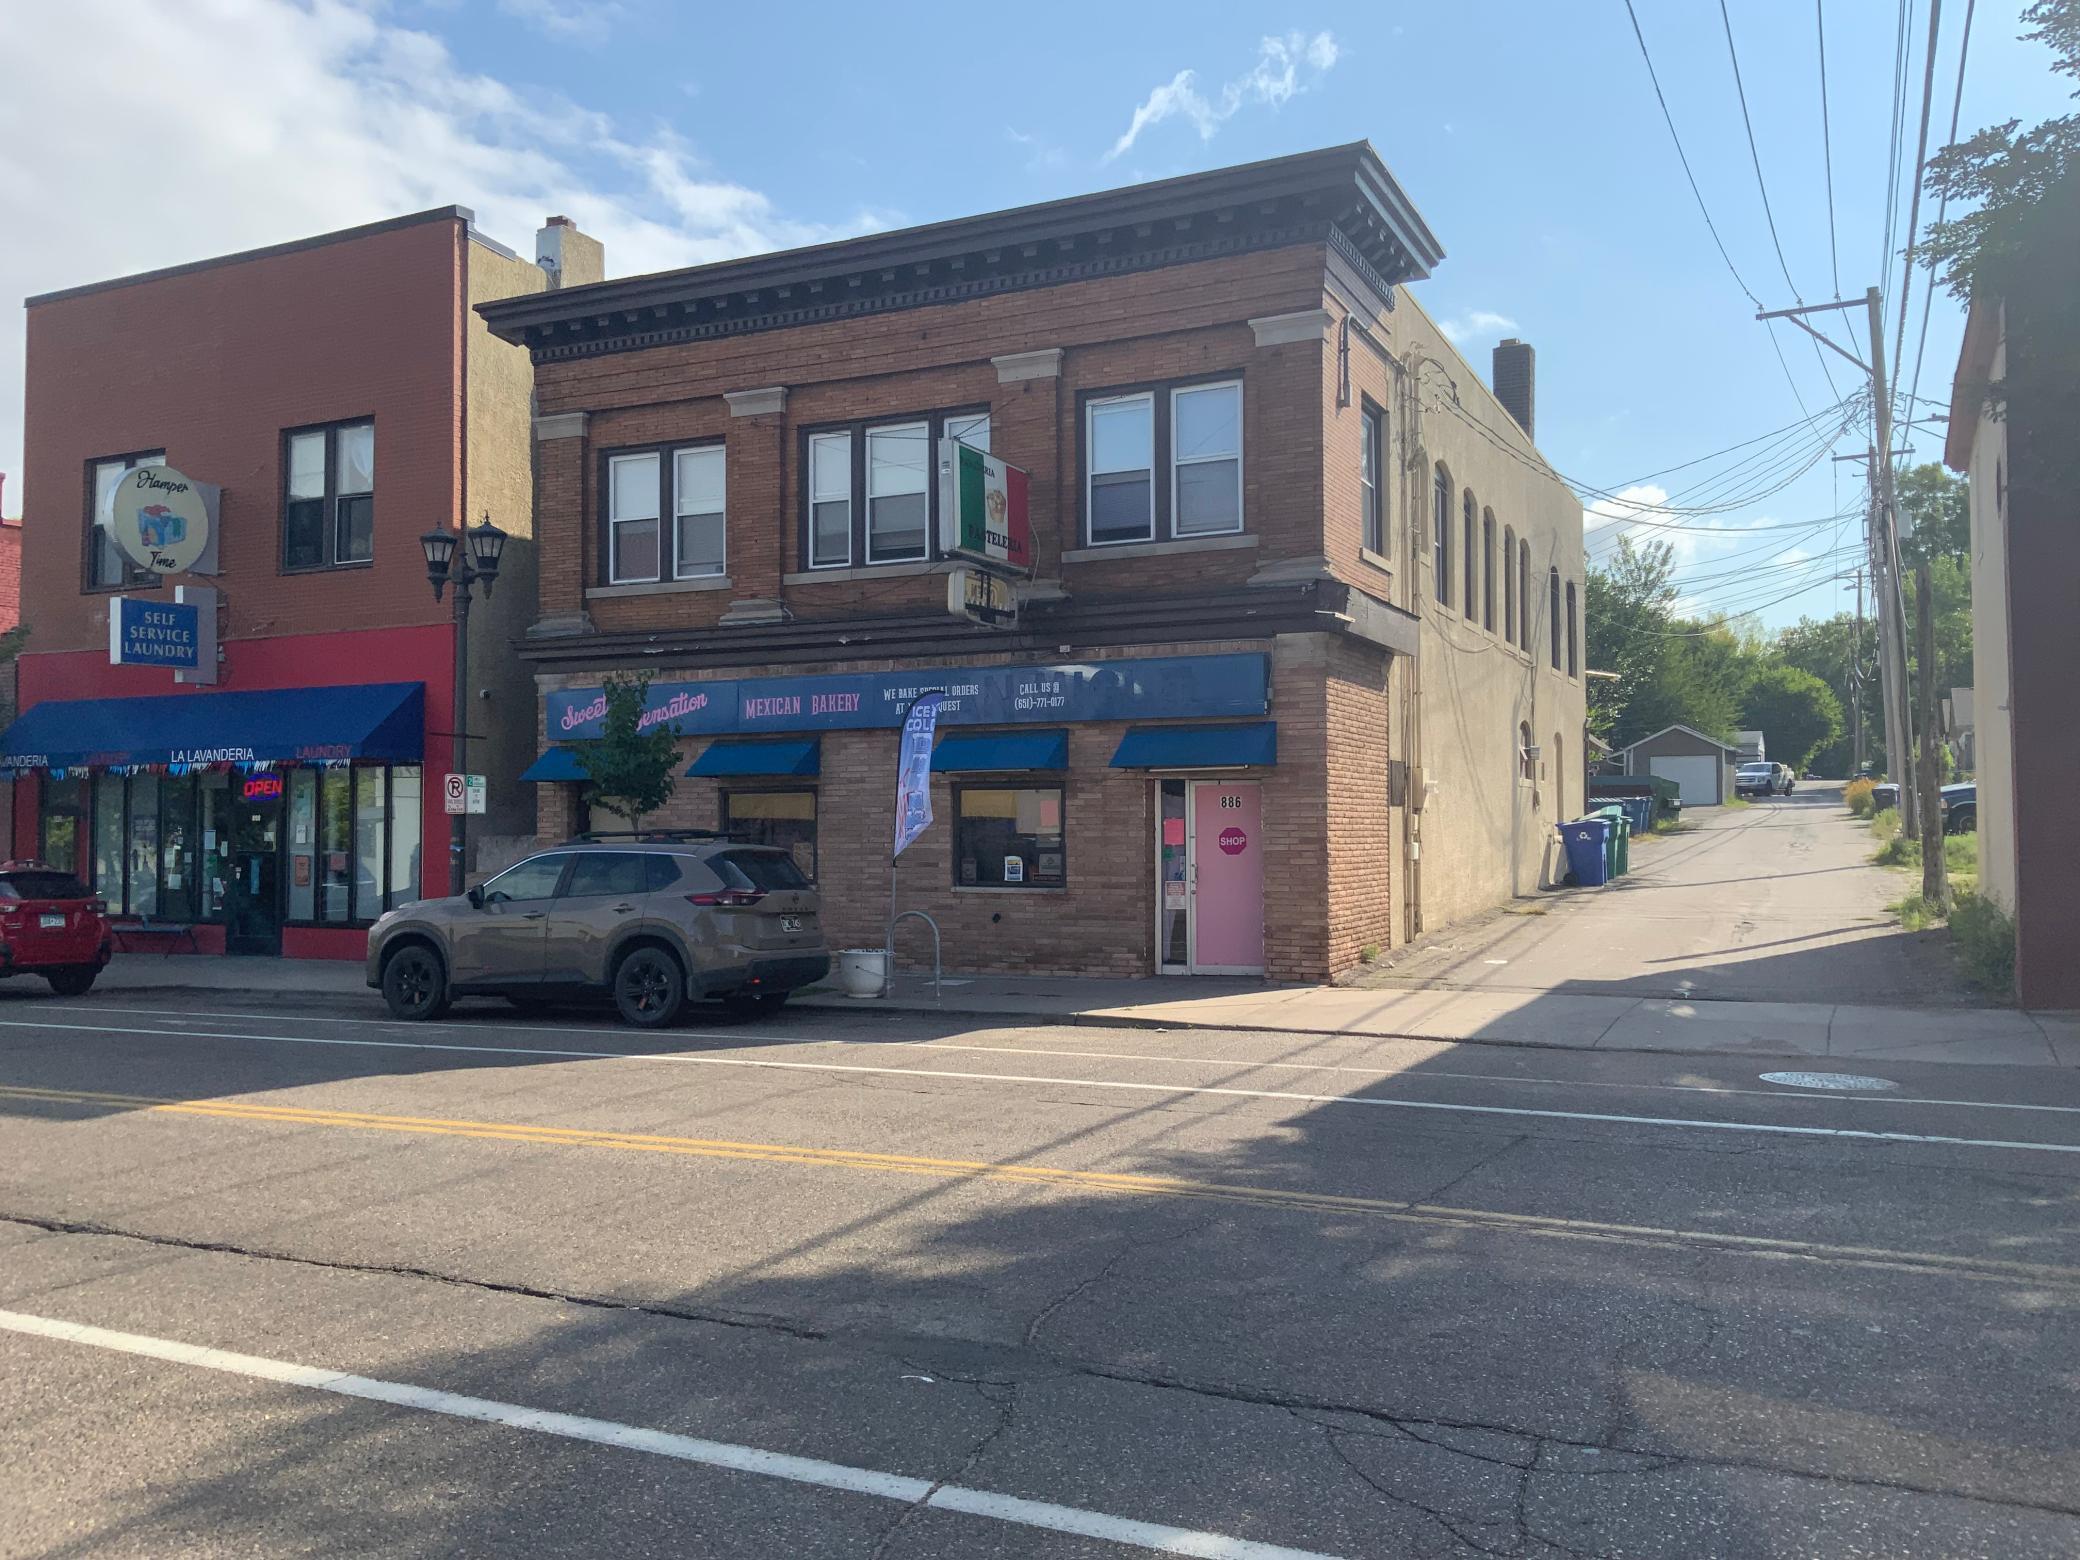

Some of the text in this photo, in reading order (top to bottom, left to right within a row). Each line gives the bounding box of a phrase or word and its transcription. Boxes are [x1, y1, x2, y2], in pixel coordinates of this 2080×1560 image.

[137, 470, 189, 495] Hamper
[151, 551, 177, 569] Time
[144, 611, 176, 626] SELF
[130, 625, 190, 643] SERVICE
[124, 642, 195, 658] LAUNDRY
[884, 687, 896, 700] WE
[898, 687, 917, 698] BAKE
[952, 684, 979, 696] ORDERS
[1020, 684, 1038, 695] CALL
[1041, 682, 1050, 692] US
[561, 694, 609, 730] Sweet
[746, 693, 860, 718] MEXICAN BAKERY
[895, 703, 904, 715] AT
[171, 747, 254, 763] LA LAVANDERIA
[296, 745, 352, 759] LAUNDRY
[243, 779, 283, 796] OPEN
[1221, 796, 1241, 808] 886
[1220, 836, 1246, 846] SHOP
